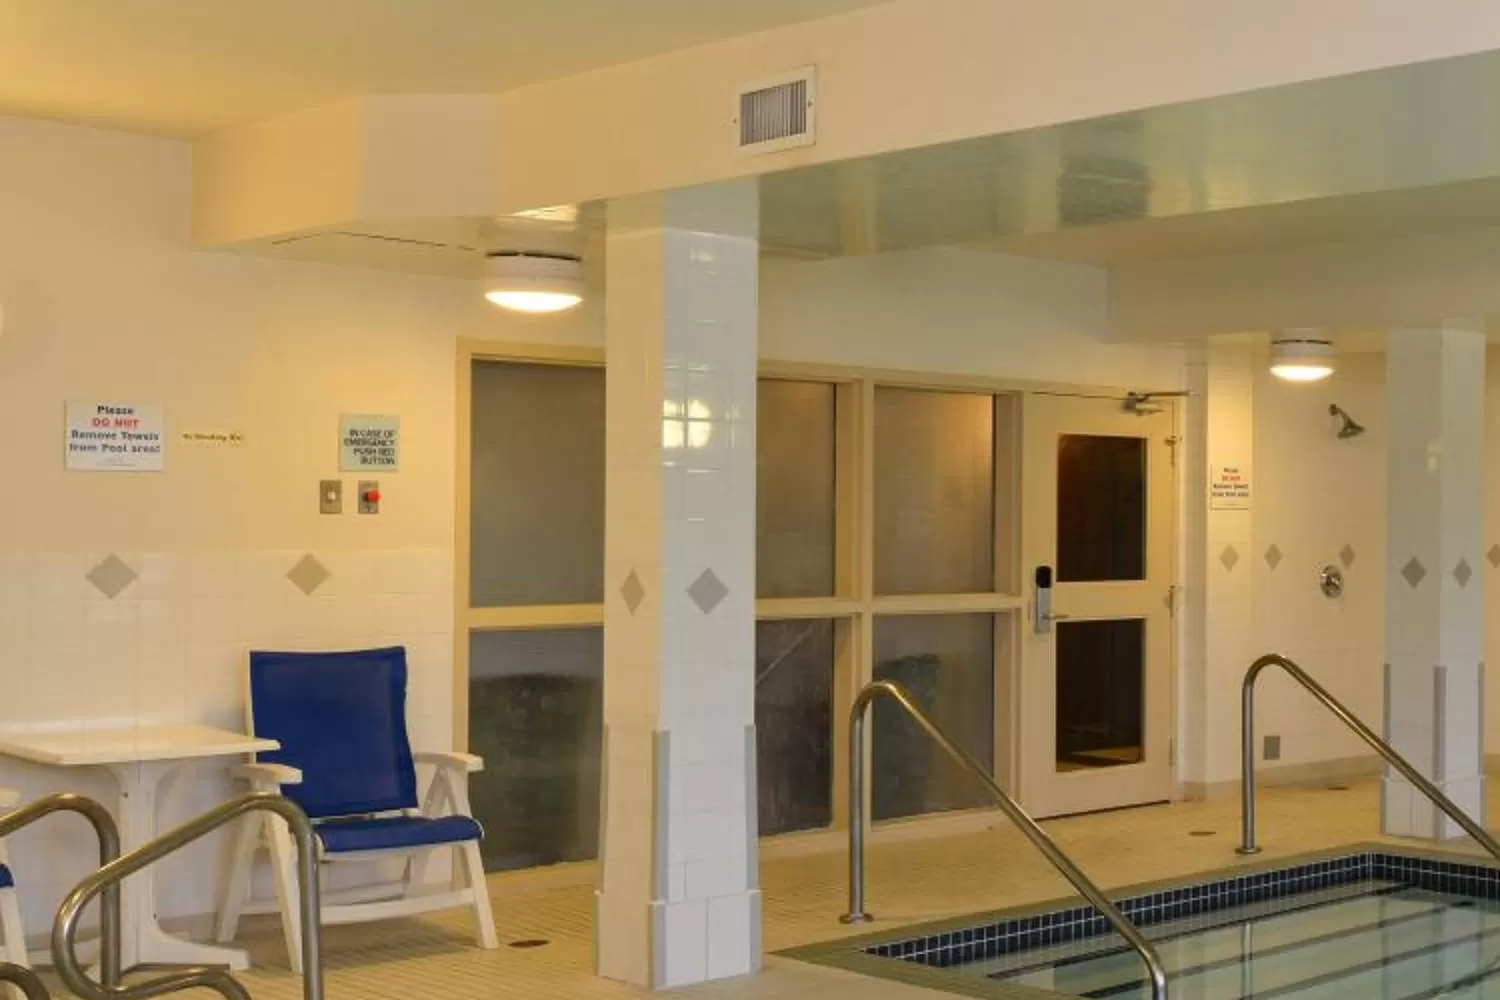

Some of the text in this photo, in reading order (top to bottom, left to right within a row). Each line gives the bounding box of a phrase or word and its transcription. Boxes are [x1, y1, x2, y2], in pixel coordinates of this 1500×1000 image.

[97, 404, 135, 416] Please
[91, 417, 111, 429] DO
[71, 429, 160, 441] Remove Towels
[69, 442, 98, 453] from
[101, 443, 128, 453] Pool
